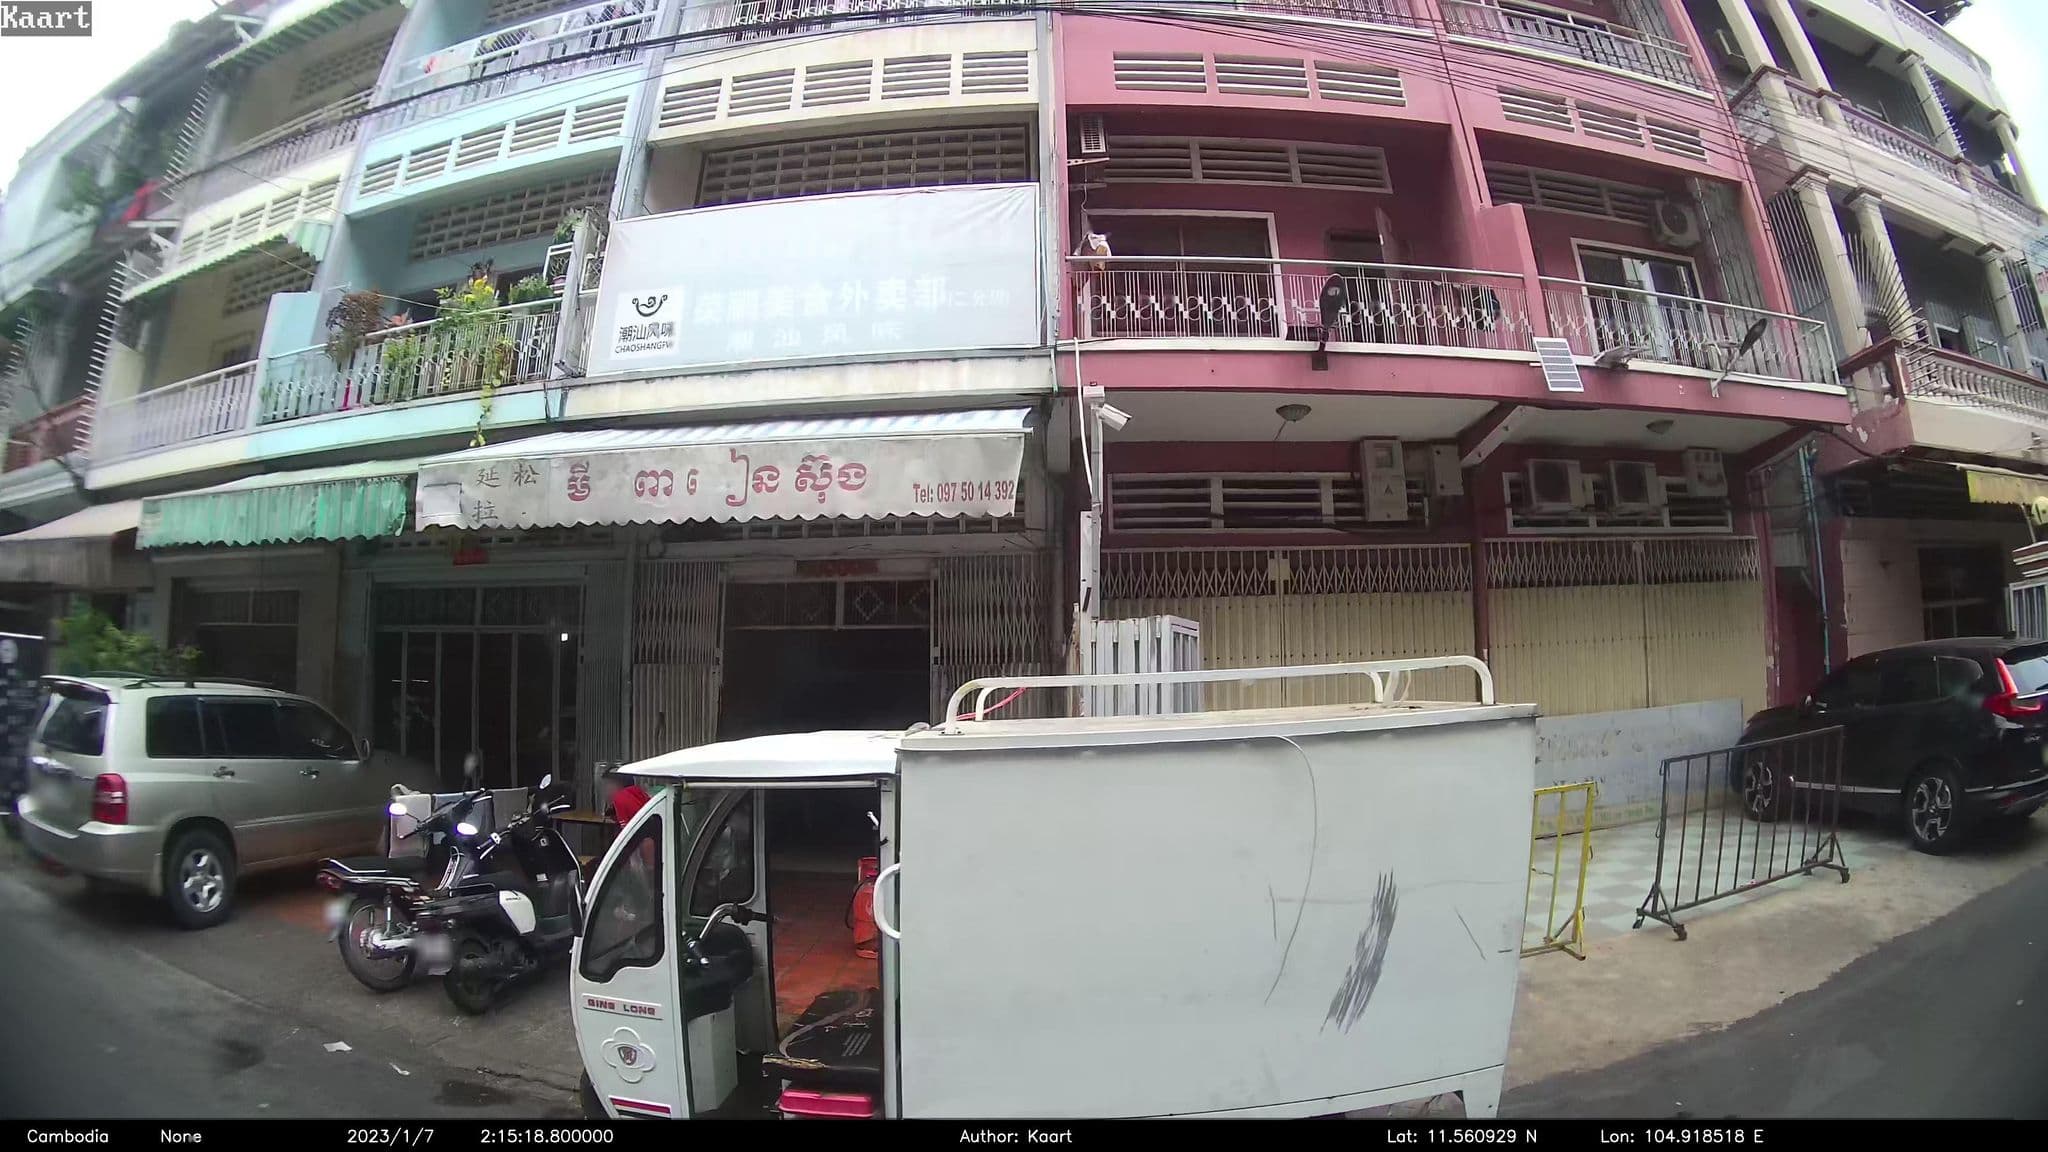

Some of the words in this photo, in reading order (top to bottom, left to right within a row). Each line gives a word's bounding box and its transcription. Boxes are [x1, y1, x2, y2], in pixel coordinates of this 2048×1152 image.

[912, 483, 934, 503] Tel:
[937, 482, 958, 502] 097
[961, 481, 975, 501] 50
[978, 480, 991, 500] 14
[994, 480, 1016, 500] 392
